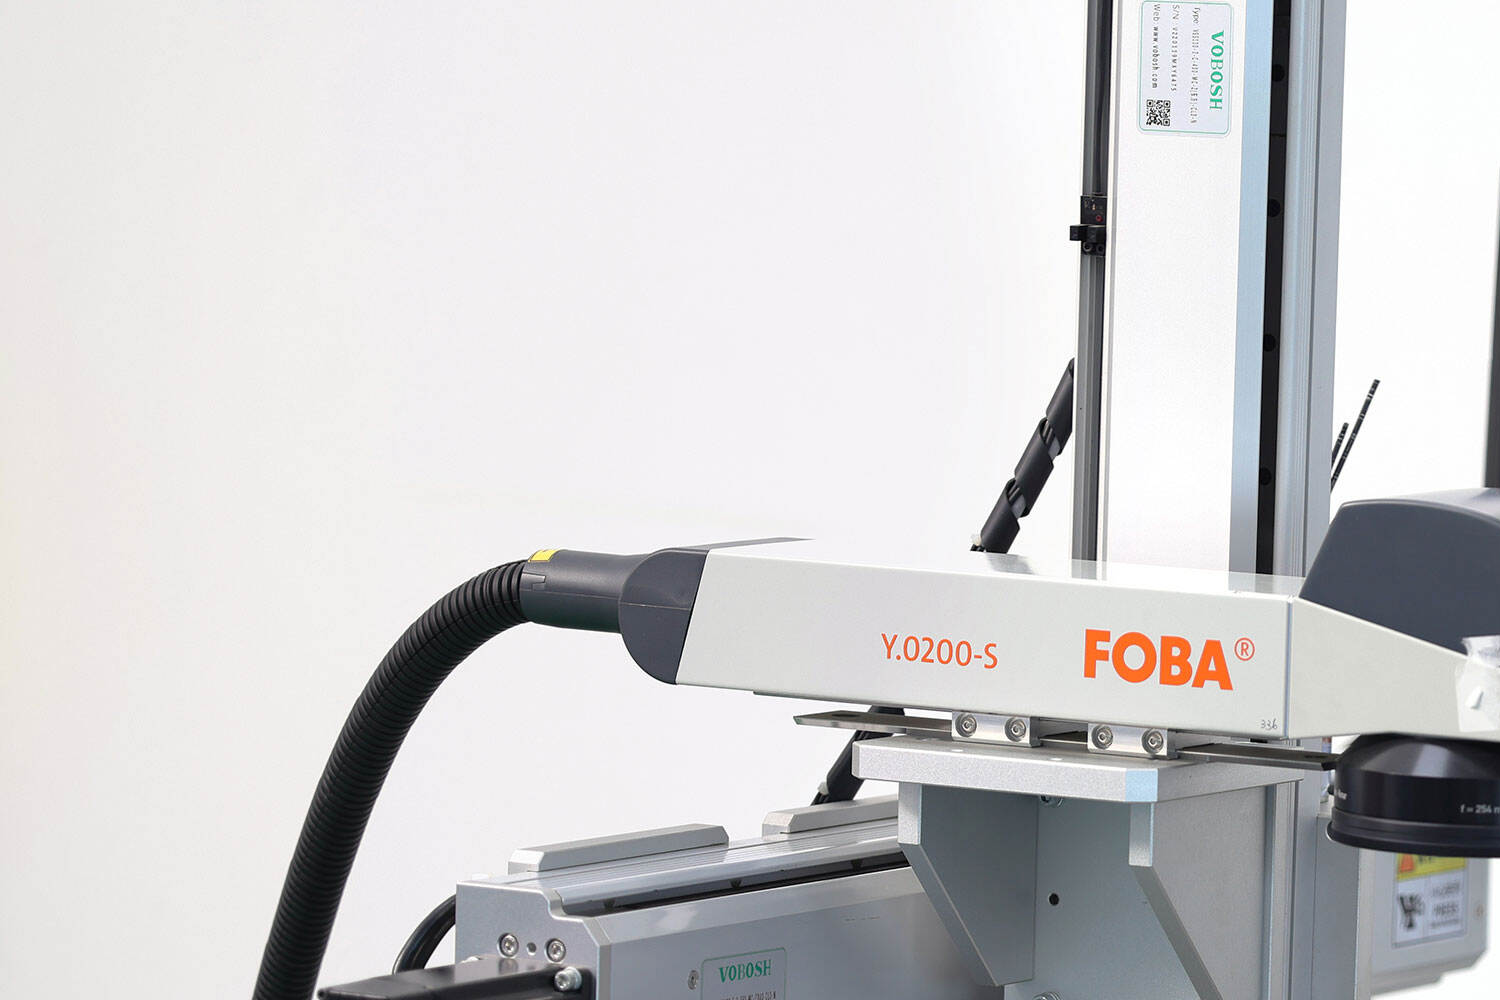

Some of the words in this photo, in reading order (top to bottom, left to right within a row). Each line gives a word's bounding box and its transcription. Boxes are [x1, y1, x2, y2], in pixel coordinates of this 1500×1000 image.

[1152, 26, 1160, 89] www.vobosh.com
[1209, 29, 1225, 110] VOBOSH
[881, 633, 998, 670] Y.0200-S
[719, 958, 772, 983] VOBOSH
